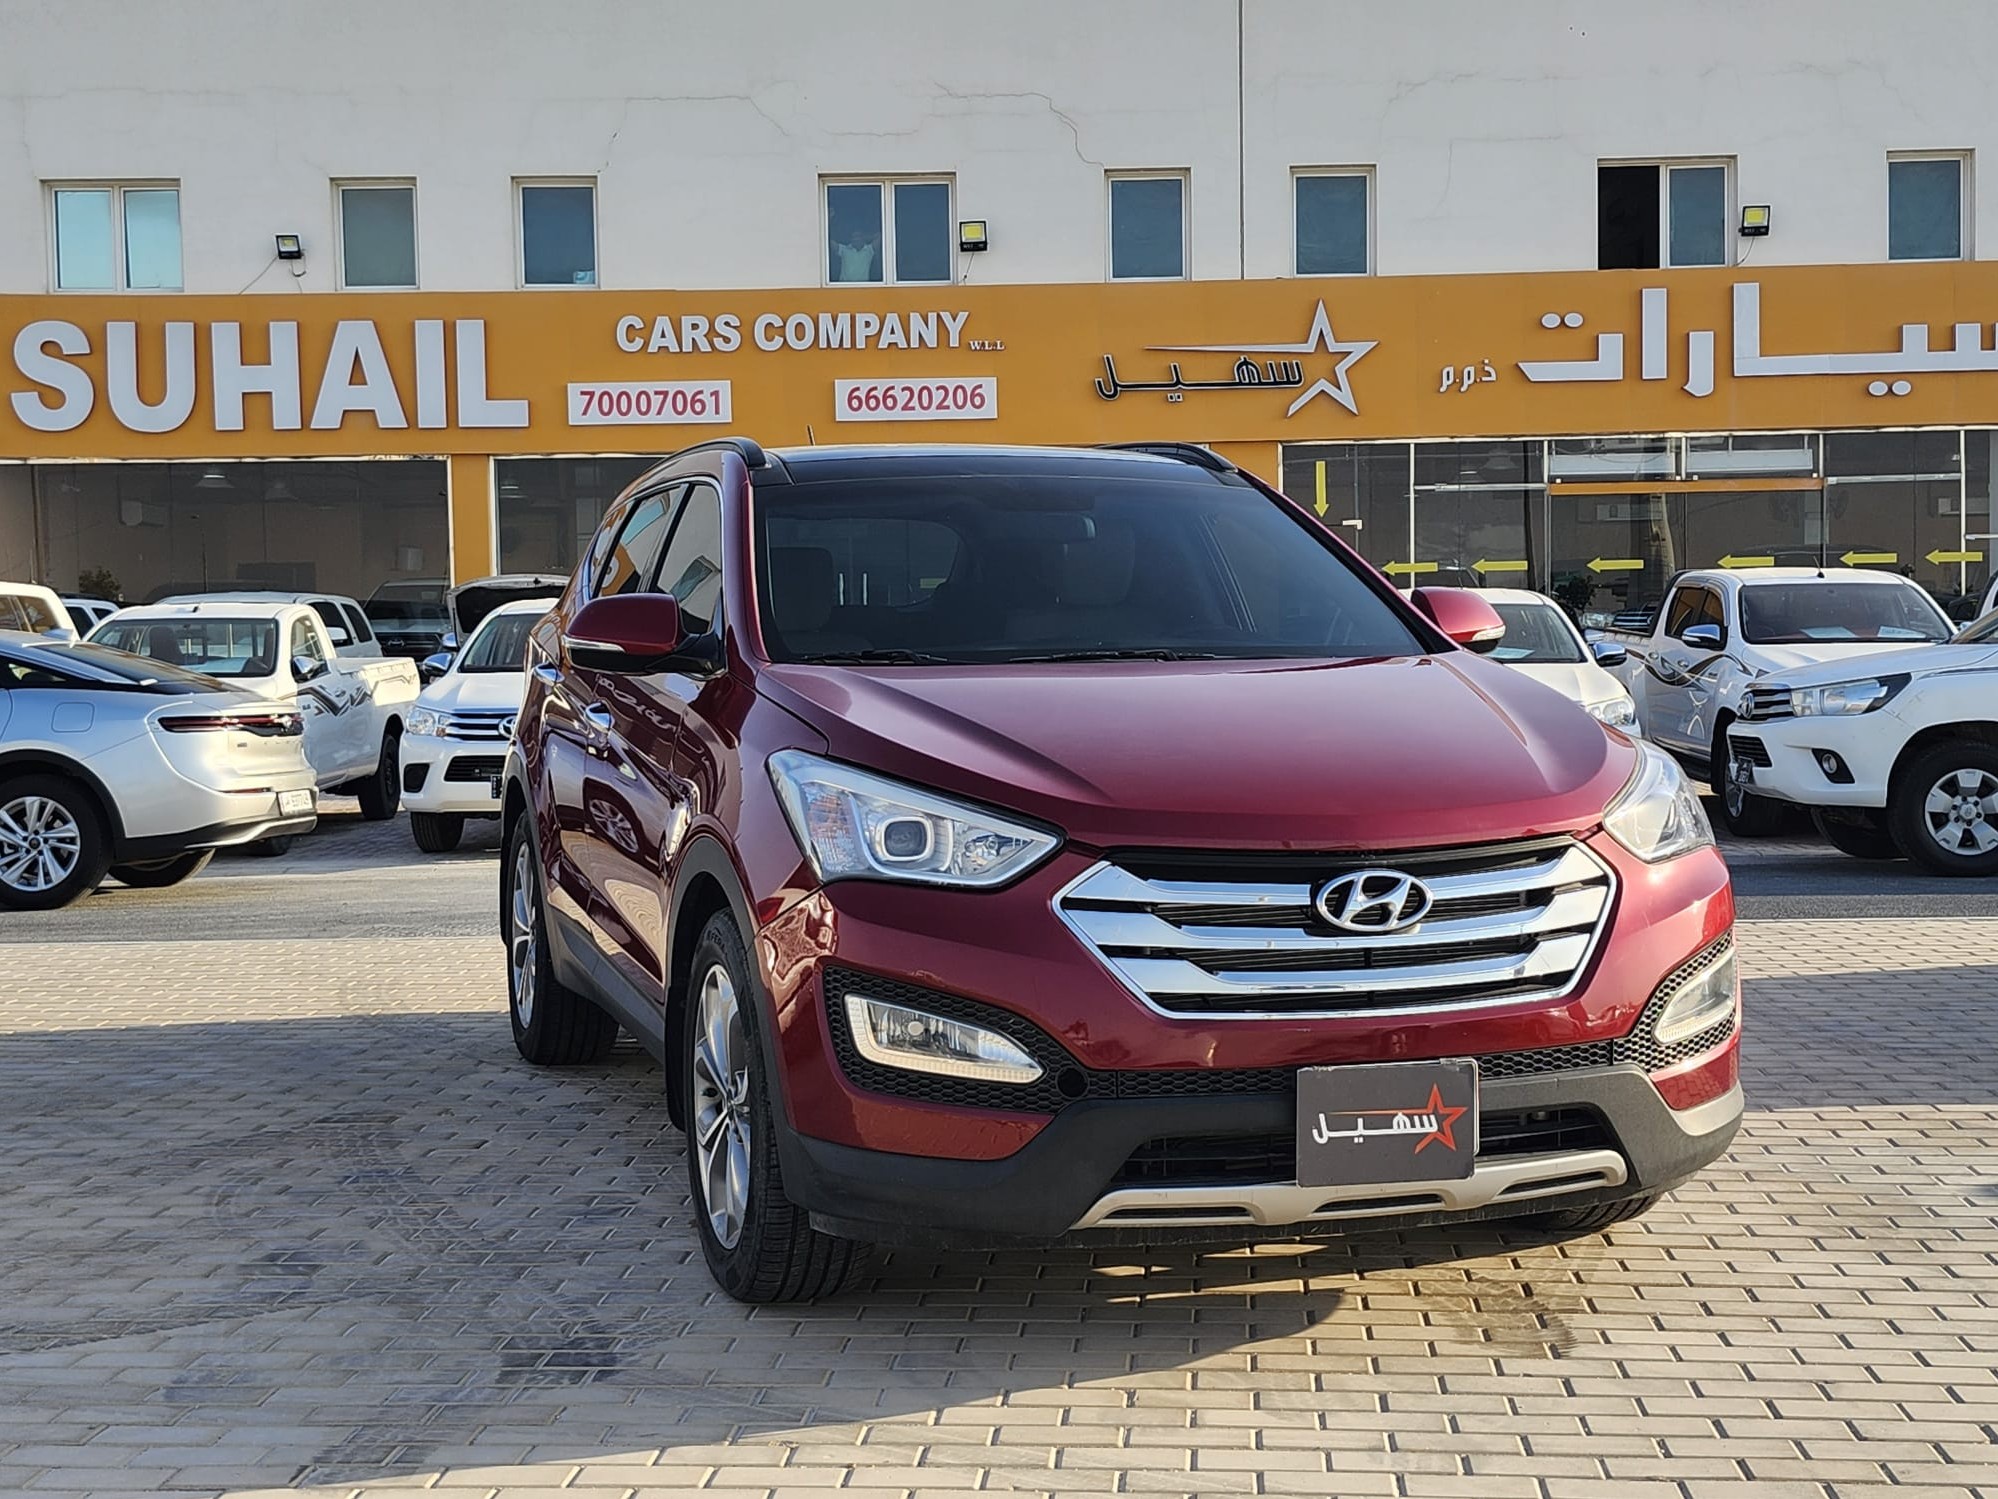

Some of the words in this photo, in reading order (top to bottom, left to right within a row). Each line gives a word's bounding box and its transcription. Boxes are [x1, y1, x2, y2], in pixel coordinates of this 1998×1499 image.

[615, 314, 741, 353] CARS
[754, 311, 970, 352] COMPANY
[10, 319, 530, 434] SUHAIL
[1095, 354, 1304, 402] سهيل
[580, 390, 722, 417] 70007061
[846, 384, 987, 412] 66620206
[1312, 1112, 1439, 1144] سهيل
